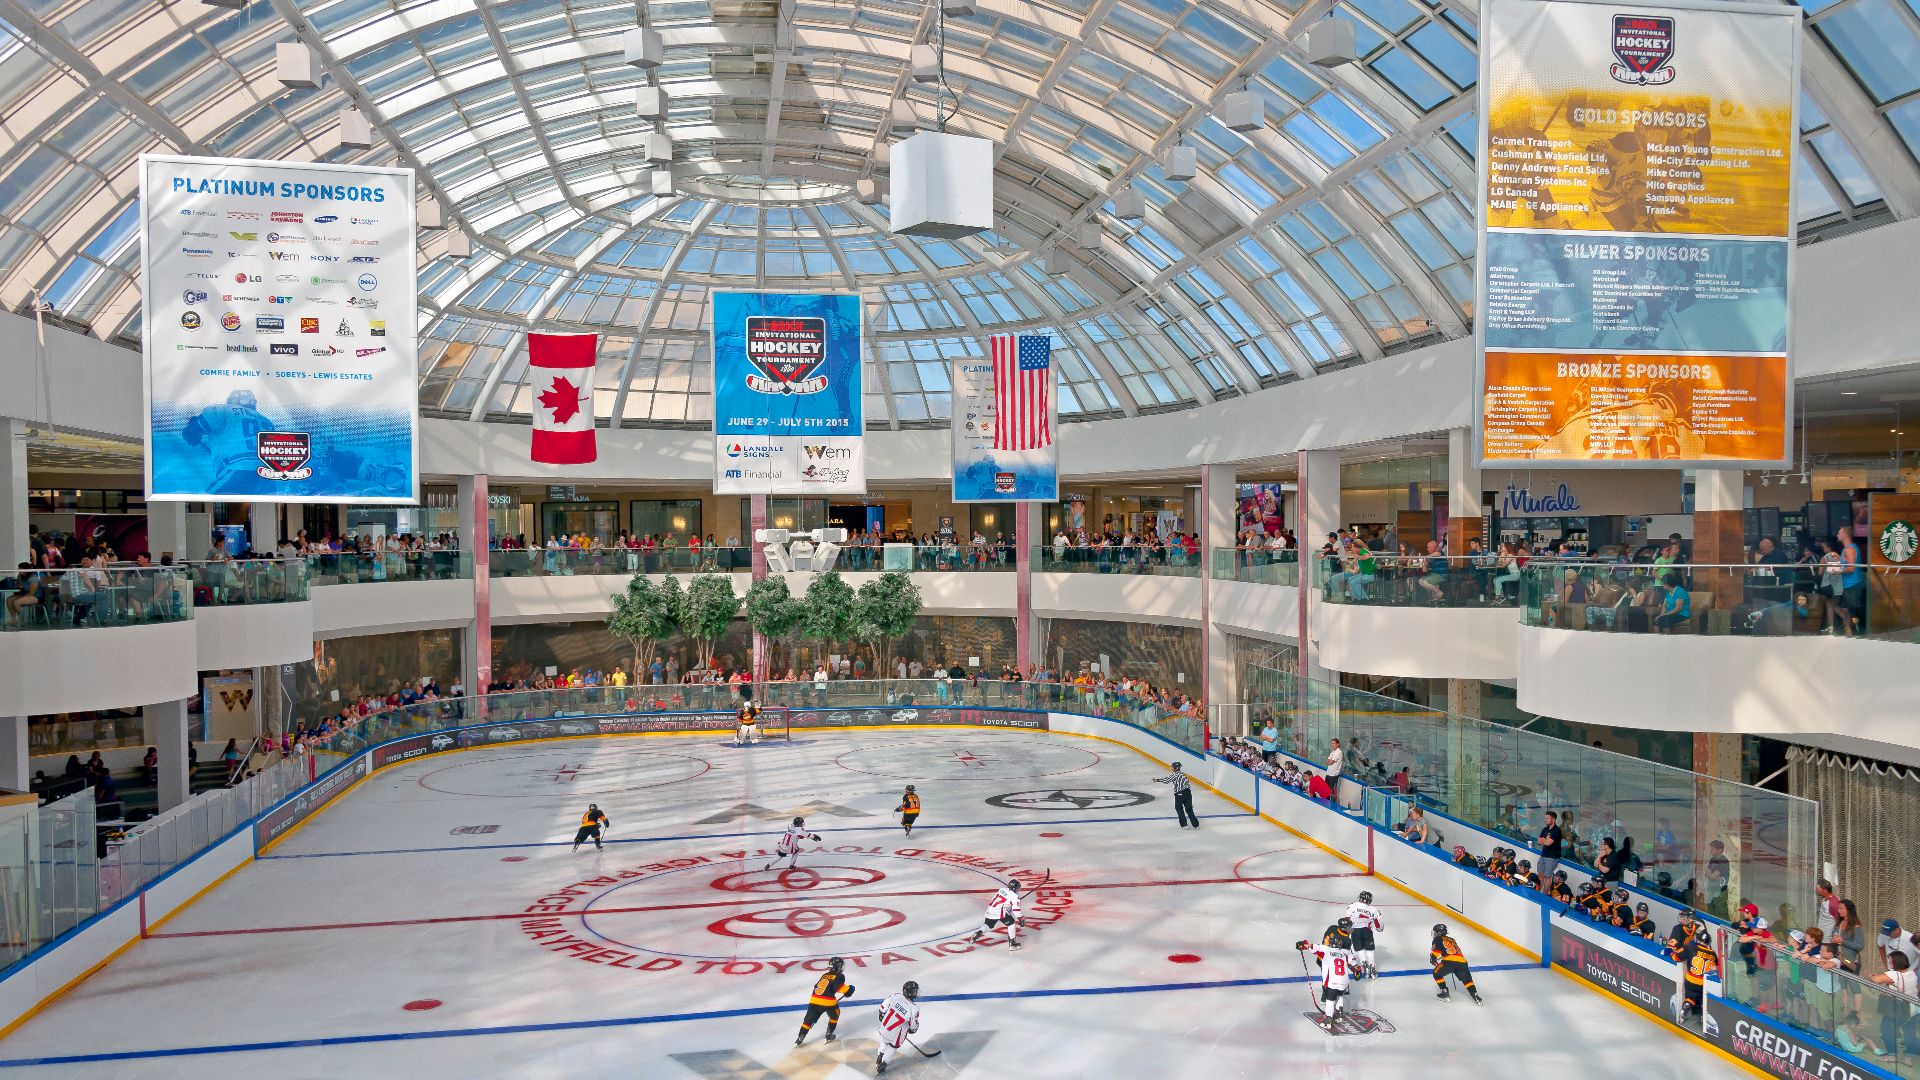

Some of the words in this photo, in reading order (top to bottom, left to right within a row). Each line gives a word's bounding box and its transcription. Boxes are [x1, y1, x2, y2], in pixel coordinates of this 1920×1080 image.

[1617, 37, 1670, 49] HOCKEY
[1573, 108, 1616, 125] GOLD
[1621, 109, 1706, 129] SPONSORS
[1492, 136, 1525, 145] Carmel
[1528, 138, 1571, 148] Transport
[1492, 149, 1533, 158] Cushman
[1545, 151, 1588, 161] Wakefield
[1591, 154, 1607, 162] Ltd.
[1647, 143, 1680, 152] McLean
[1682, 145, 1708, 155] Young
[1711, 146, 1764, 156] Construction
[1767, 149, 1783, 157] Ltd.
[1492, 162, 1520, 172] Denny
[1522, 163, 1561, 172] Andrews
[1564, 165, 1583, 173] Ford
[1586, 166, 1610, 174] Sales
[1647, 156, 1682, 166] Mid-City
[1686, 158, 1731, 168] Excavating
[1492, 175, 1532, 184] Kumaran
[1535, 176, 1571, 186] Systems
[1669, 170, 1700, 178] Comrie
[173, 177, 275, 197] PLATINUM
[281, 182, 385, 202] SPONSORS
[1506, 188, 1537, 197] Canada
[1667, 182, 1704, 191] Graphics
[1646, 193, 1685, 204] Samsung
[1688, 195, 1734, 204] Appliances
[1491, 200, 1517, 209] MABE
[1540, 202, 1588, 212] Appliances
[1564, 244, 1619, 260] SILVER
[1624, 245, 1710, 262] SPONSORS
[751, 342, 822, 353] HOCKEY
[1557, 362, 1621, 378] BRONZE
[1626, 363, 1711, 379] SPONSORS
[745, 470, 781, 478] Financial
[989, 894, 1007, 907] 17
[520, 918, 682, 972] MAYFIELD
[693, 950, 918, 975] TOYOTA
[1334, 958, 1344, 976] 8
[1587, 948, 1662, 994] MAYFIELD
[1587, 964, 1617, 987] TOYOTA
[814, 979, 829, 995] 9
[883, 1008, 905, 1031] 17
[1735, 1020, 1812, 1068] CREDIT
